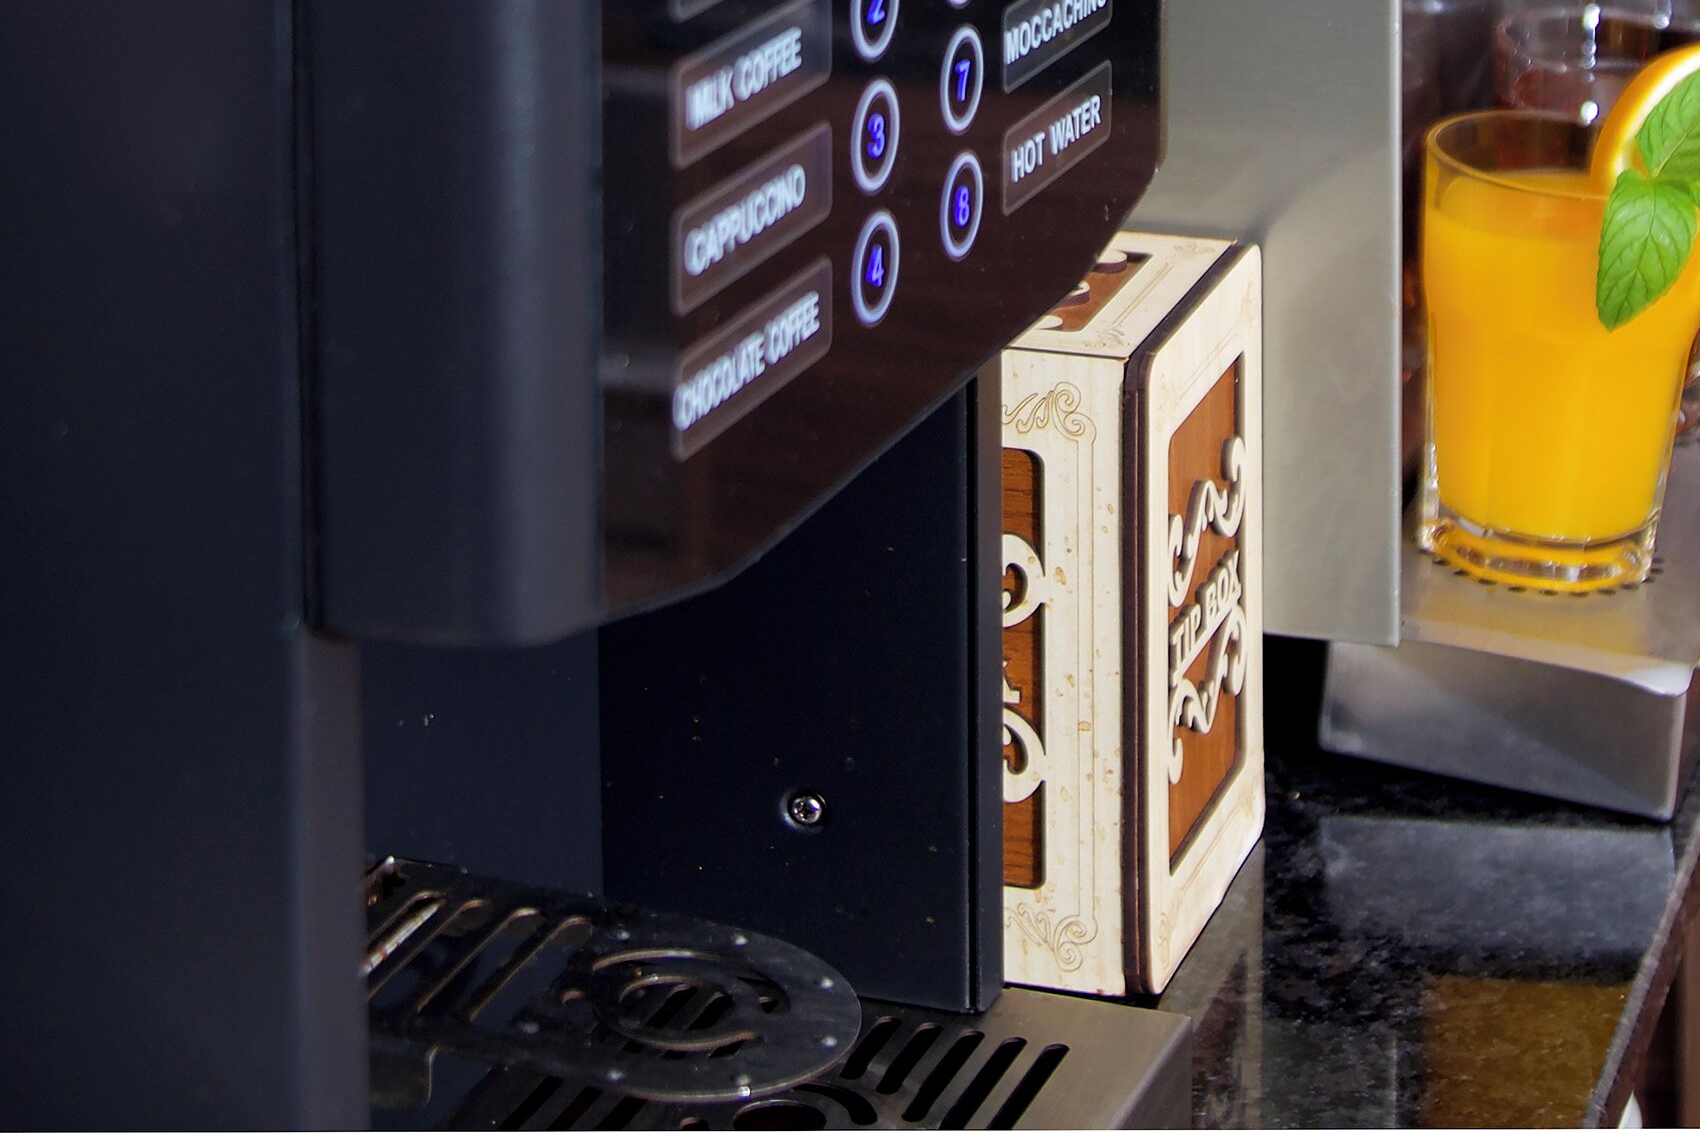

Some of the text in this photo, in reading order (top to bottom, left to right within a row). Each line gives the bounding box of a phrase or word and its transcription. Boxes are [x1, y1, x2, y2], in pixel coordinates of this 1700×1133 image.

[686, 27, 801, 131] MILK COFFEE
[955, 60, 970, 102] 7
[868, 113, 886, 160] 3
[1012, 94, 1101, 183] HOT WATER
[685, 164, 806, 277] CAPPUCCINO
[954, 185, 970, 228] 8
[866, 244, 884, 287] 4
[673, 291, 820, 431] CHOCOLATE COFFEE
[1170, 549, 1243, 673] TIP BOX
